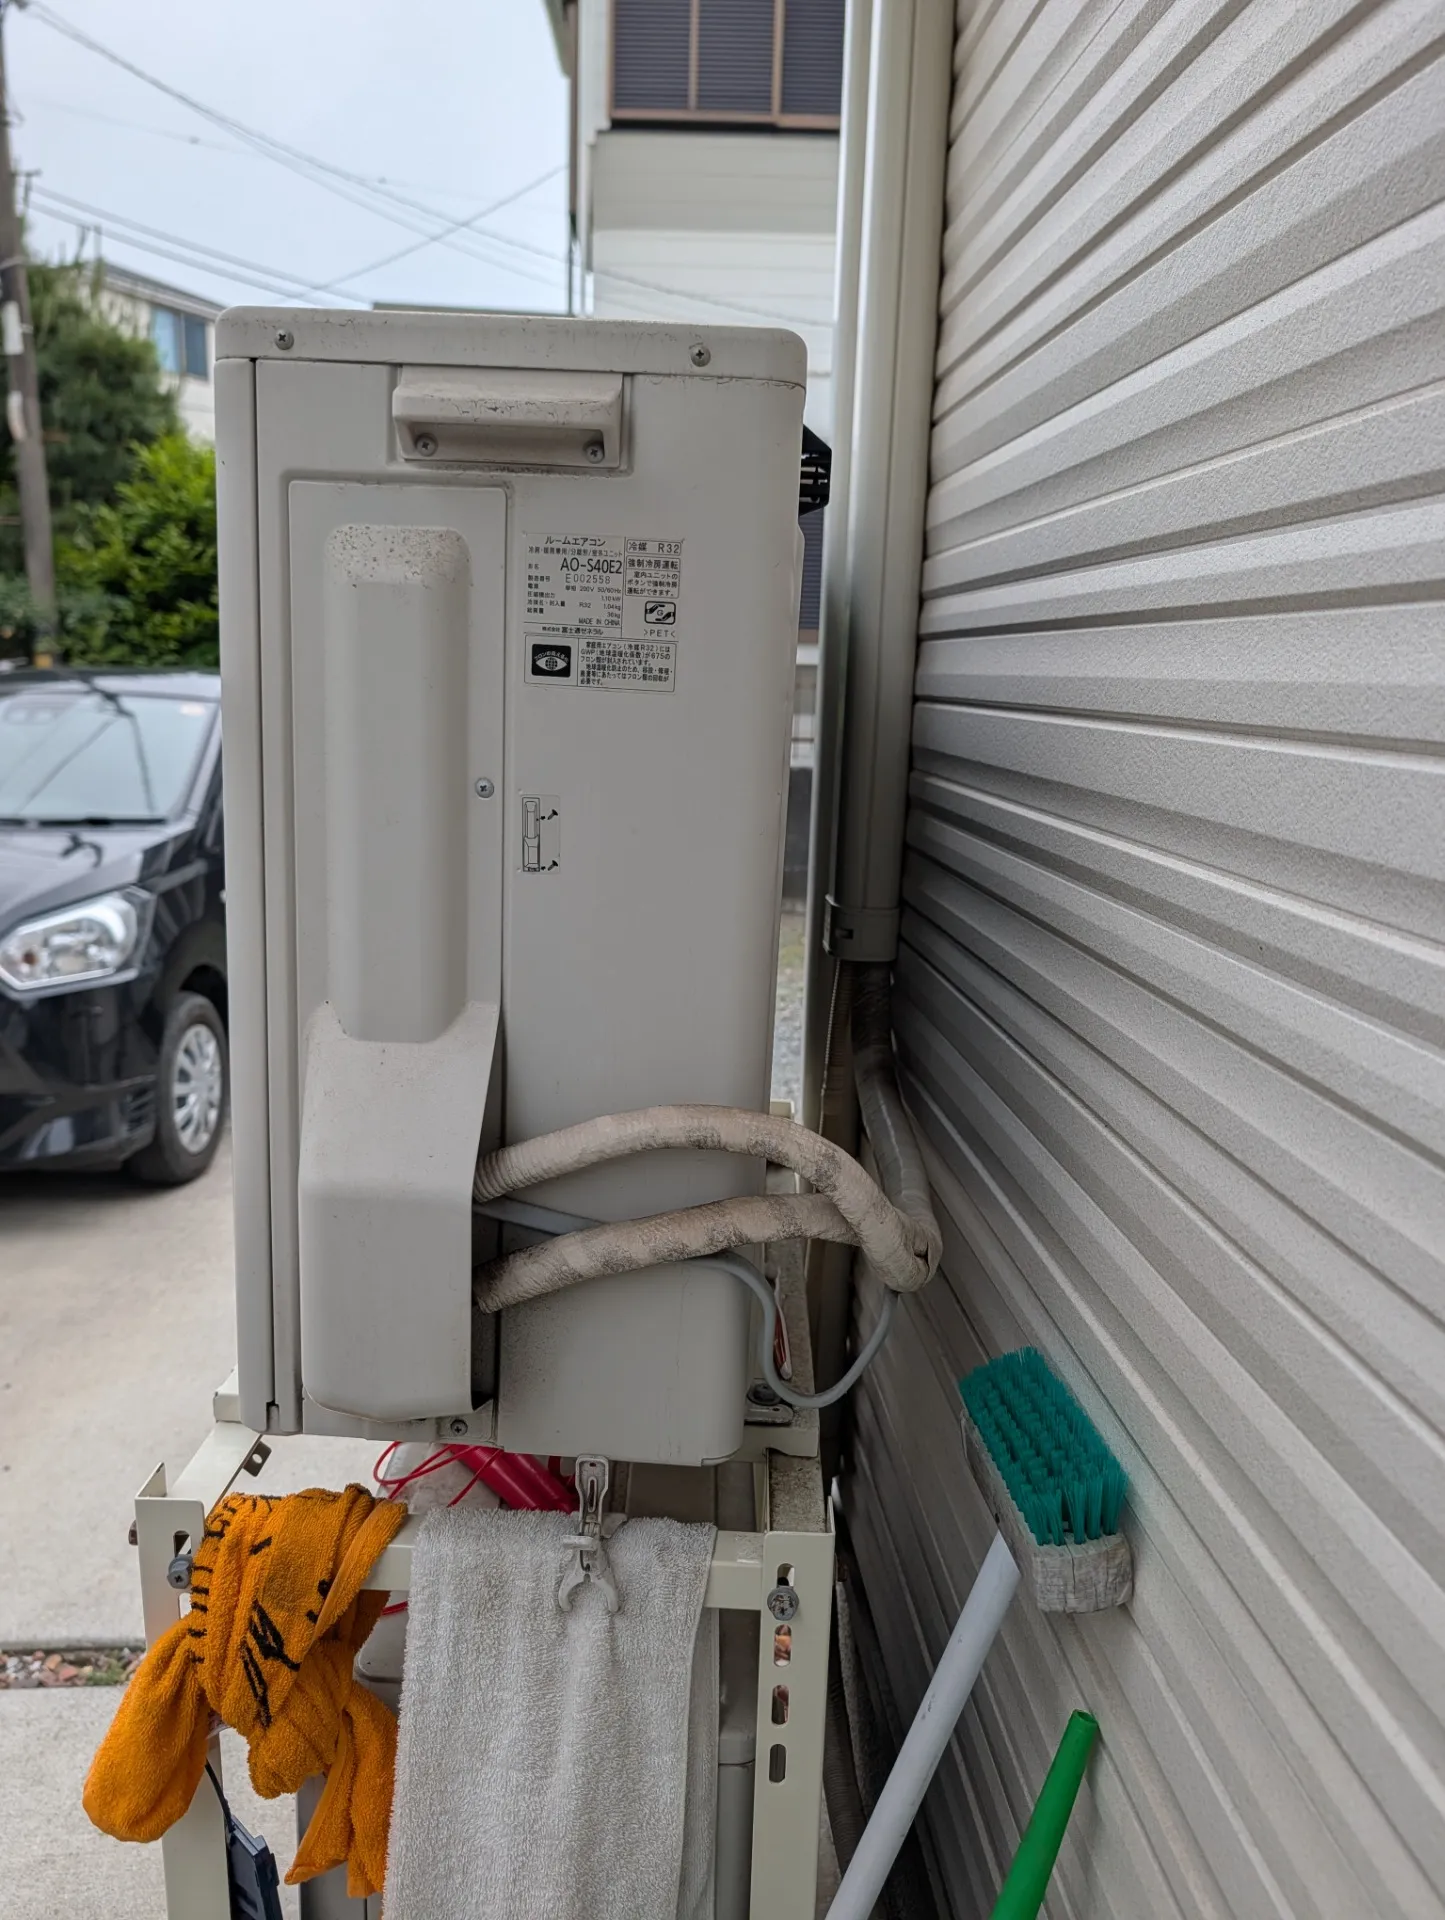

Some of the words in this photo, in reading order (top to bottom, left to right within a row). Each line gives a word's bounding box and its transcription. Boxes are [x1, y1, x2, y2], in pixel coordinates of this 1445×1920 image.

[545, 536, 606, 547] ルームエアコン
[628, 541, 647, 551] 冷媒
[658, 543, 680, 554] R32
[560, 557, 623, 575] AO-S40E2
[628, 558, 679, 570] 強制冷房運転
[565, 573, 611, 585] E002558
[633, 571, 679, 580] 室内ユニットの
